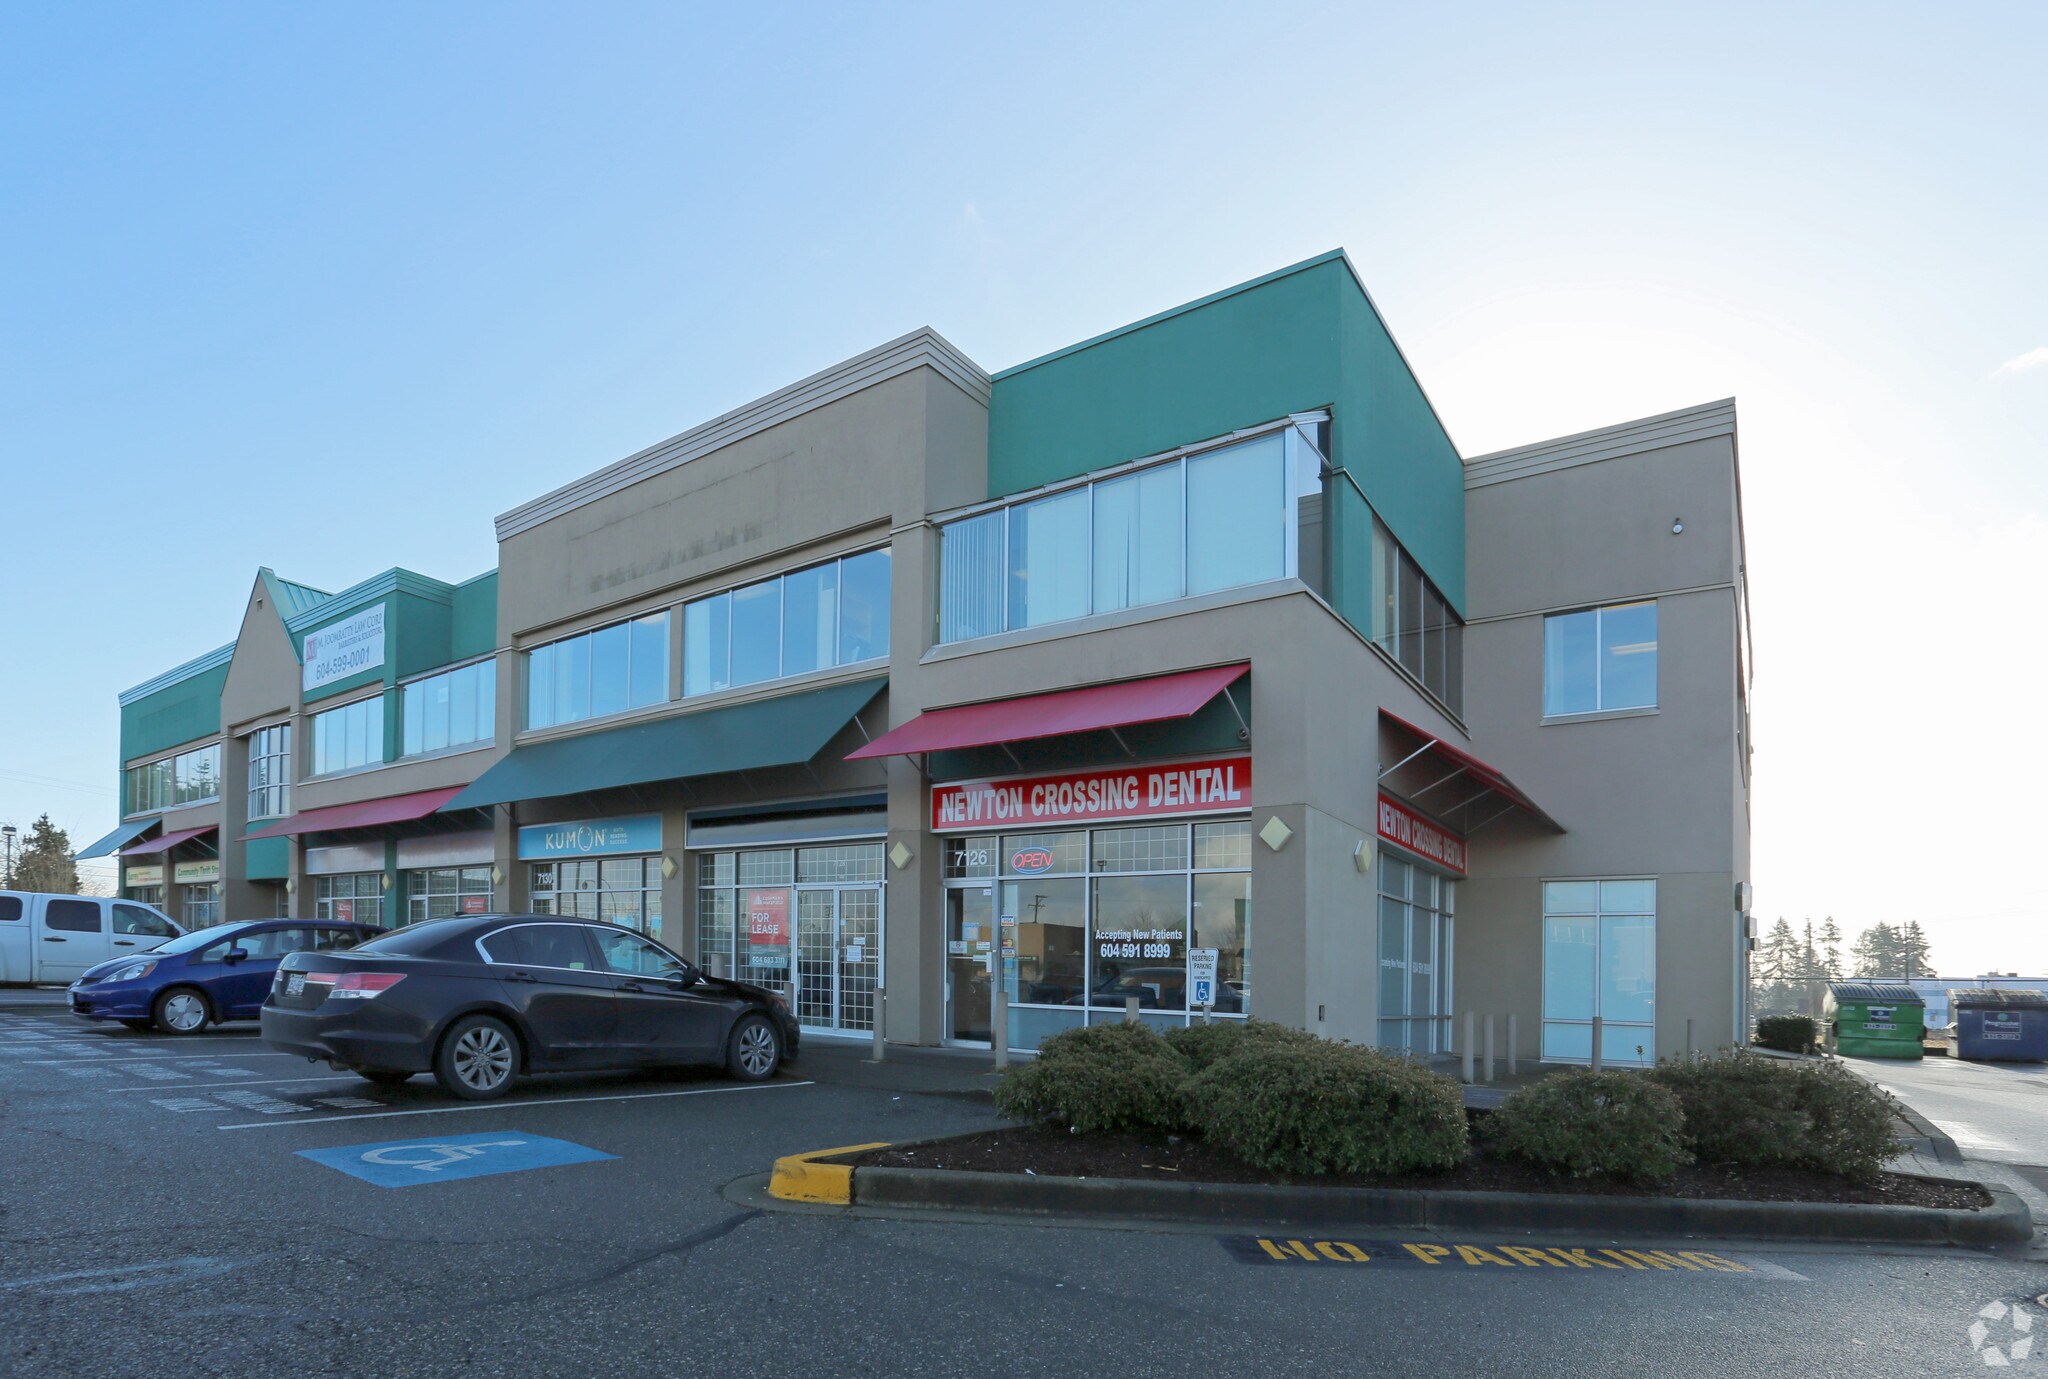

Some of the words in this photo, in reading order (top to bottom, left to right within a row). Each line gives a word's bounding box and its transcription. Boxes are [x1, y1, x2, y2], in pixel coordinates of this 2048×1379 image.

[316, 646, 370, 680] 604-599-0001
[940, 786, 1023, 823] NEWTON
[1031, 775, 1139, 817] CROSSING
[1148, 766, 1241, 808] DENTAL
[1379, 800, 1411, 845] NEWTON
[1412, 819, 1443, 860] CROSSING
[545, 826, 605, 852] KUMON
[954, 849, 988, 867] 7126
[1013, 851, 1054, 868] OPEN
[537, 872, 553, 885] 7130
[751, 912, 770, 923] FOR
[751, 924, 779, 935] LEASE
[1095, 929, 1131, 941] Accepting
[1133, 929, 1150, 940] New
[1151, 928, 1183, 940] Patients
[1100, 943, 1120, 958] 604
[1122, 943, 1141, 958] 591
[1143, 943, 1171, 958] 8999
[1193, 962, 1212, 970] PARKING
[1256, 1239, 1371, 1263] NO
[1401, 1243, 1753, 1273] PARKING
